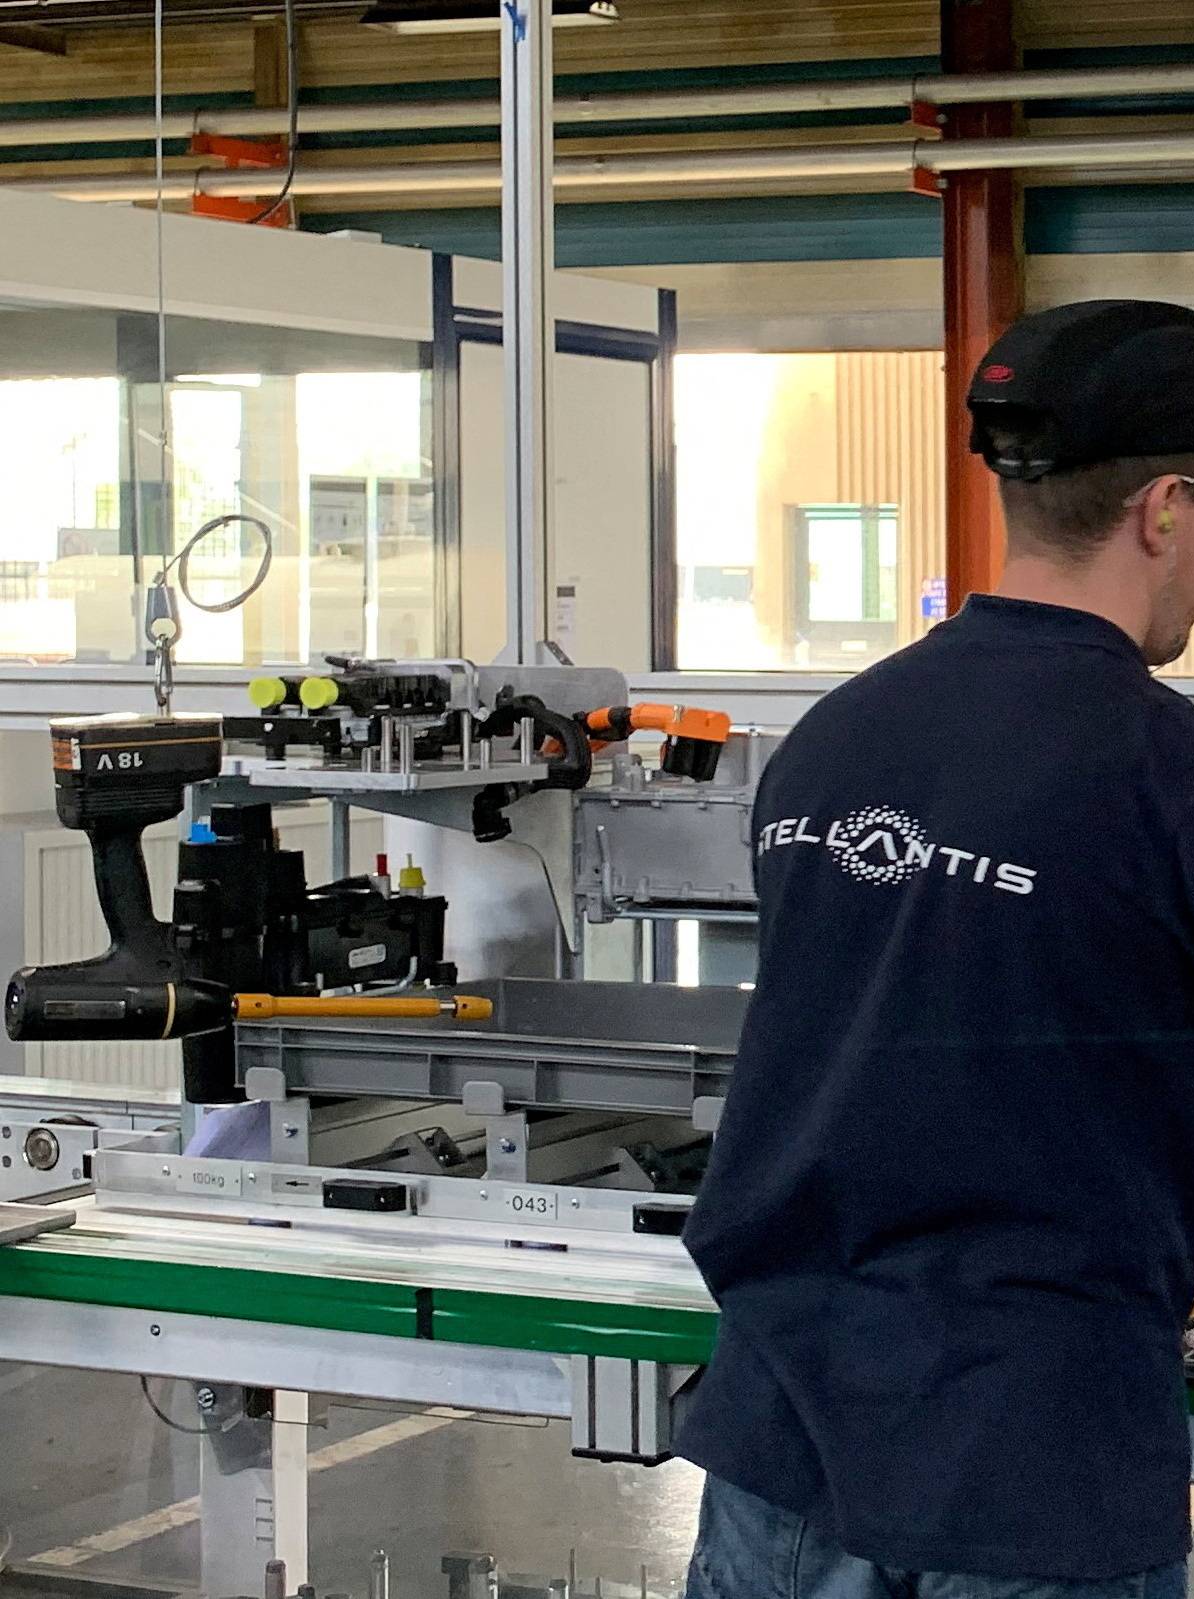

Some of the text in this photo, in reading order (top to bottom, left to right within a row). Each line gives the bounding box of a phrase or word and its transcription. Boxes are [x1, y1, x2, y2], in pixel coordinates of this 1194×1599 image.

[97, 751, 143, 770] 18 V
[192, 1172, 225, 1188] 100kg
